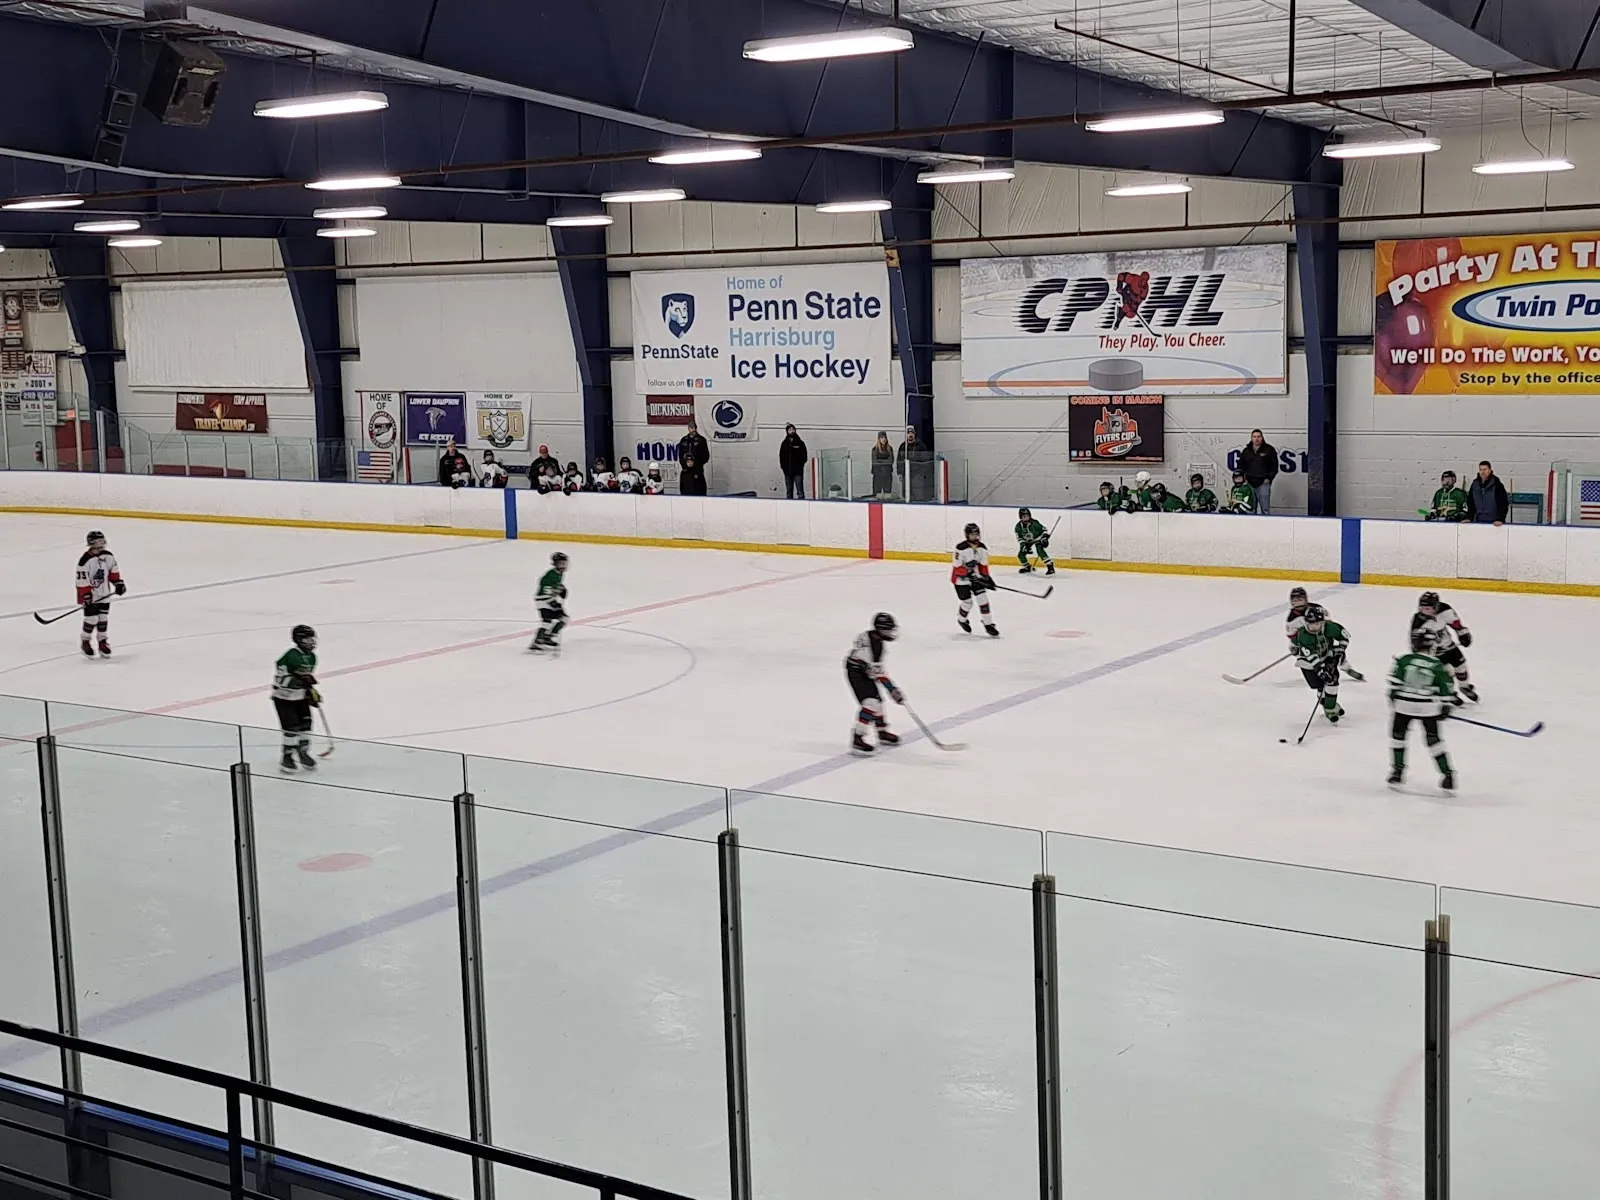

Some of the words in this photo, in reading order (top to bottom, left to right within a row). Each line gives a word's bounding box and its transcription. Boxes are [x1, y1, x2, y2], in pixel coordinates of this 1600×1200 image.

[1388, 252, 1499, 307] Party
[1510, 243, 1559, 273] At
[1571, 240, 1600, 268] T
[726, 276, 765, 290] Home
[769, 275, 784, 289] of
[728, 294, 798, 322] Penn
[804, 291, 882, 320] State
[1496, 295, 1557, 318] Twin
[1565, 293, 1600, 316] Po
[729, 326, 836, 351] Harrisburg
[1099, 334, 1127, 353] They
[1130, 333, 1159, 352] Play.
[1163, 332, 1186, 347] You
[1189, 331, 1226, 347] Cheer.
[641, 344, 719, 359] PennState
[1390, 347, 1435, 365] We'll
[1441, 348, 1466, 364] Do
[1471, 347, 1507, 364] The
[1511, 346, 1569, 365] Work,
[731, 354, 767, 379] Ice
[774, 353, 870, 385] Hockey
[1459, 372, 1496, 386] Stop
[1502, 372, 1521, 386] by
[1525, 372, 1552, 384] the
[1557, 371, 1600, 384] office
[370, 393, 392, 402] HOME
[410, 397, 432, 406] LOWER
[1070, 395, 1110, 405] COMING
[1112, 395, 1124, 405] IN
[1125, 395, 1163, 405] MARCH
[376, 402, 387, 410] OF
[650, 403, 691, 416] DICKINSON
[418, 433, 431, 441] ICE
[1096, 432, 1121, 444] FLYERS
[1121, 431, 1136, 441] CUP
[637, 442, 680, 461] HOM
